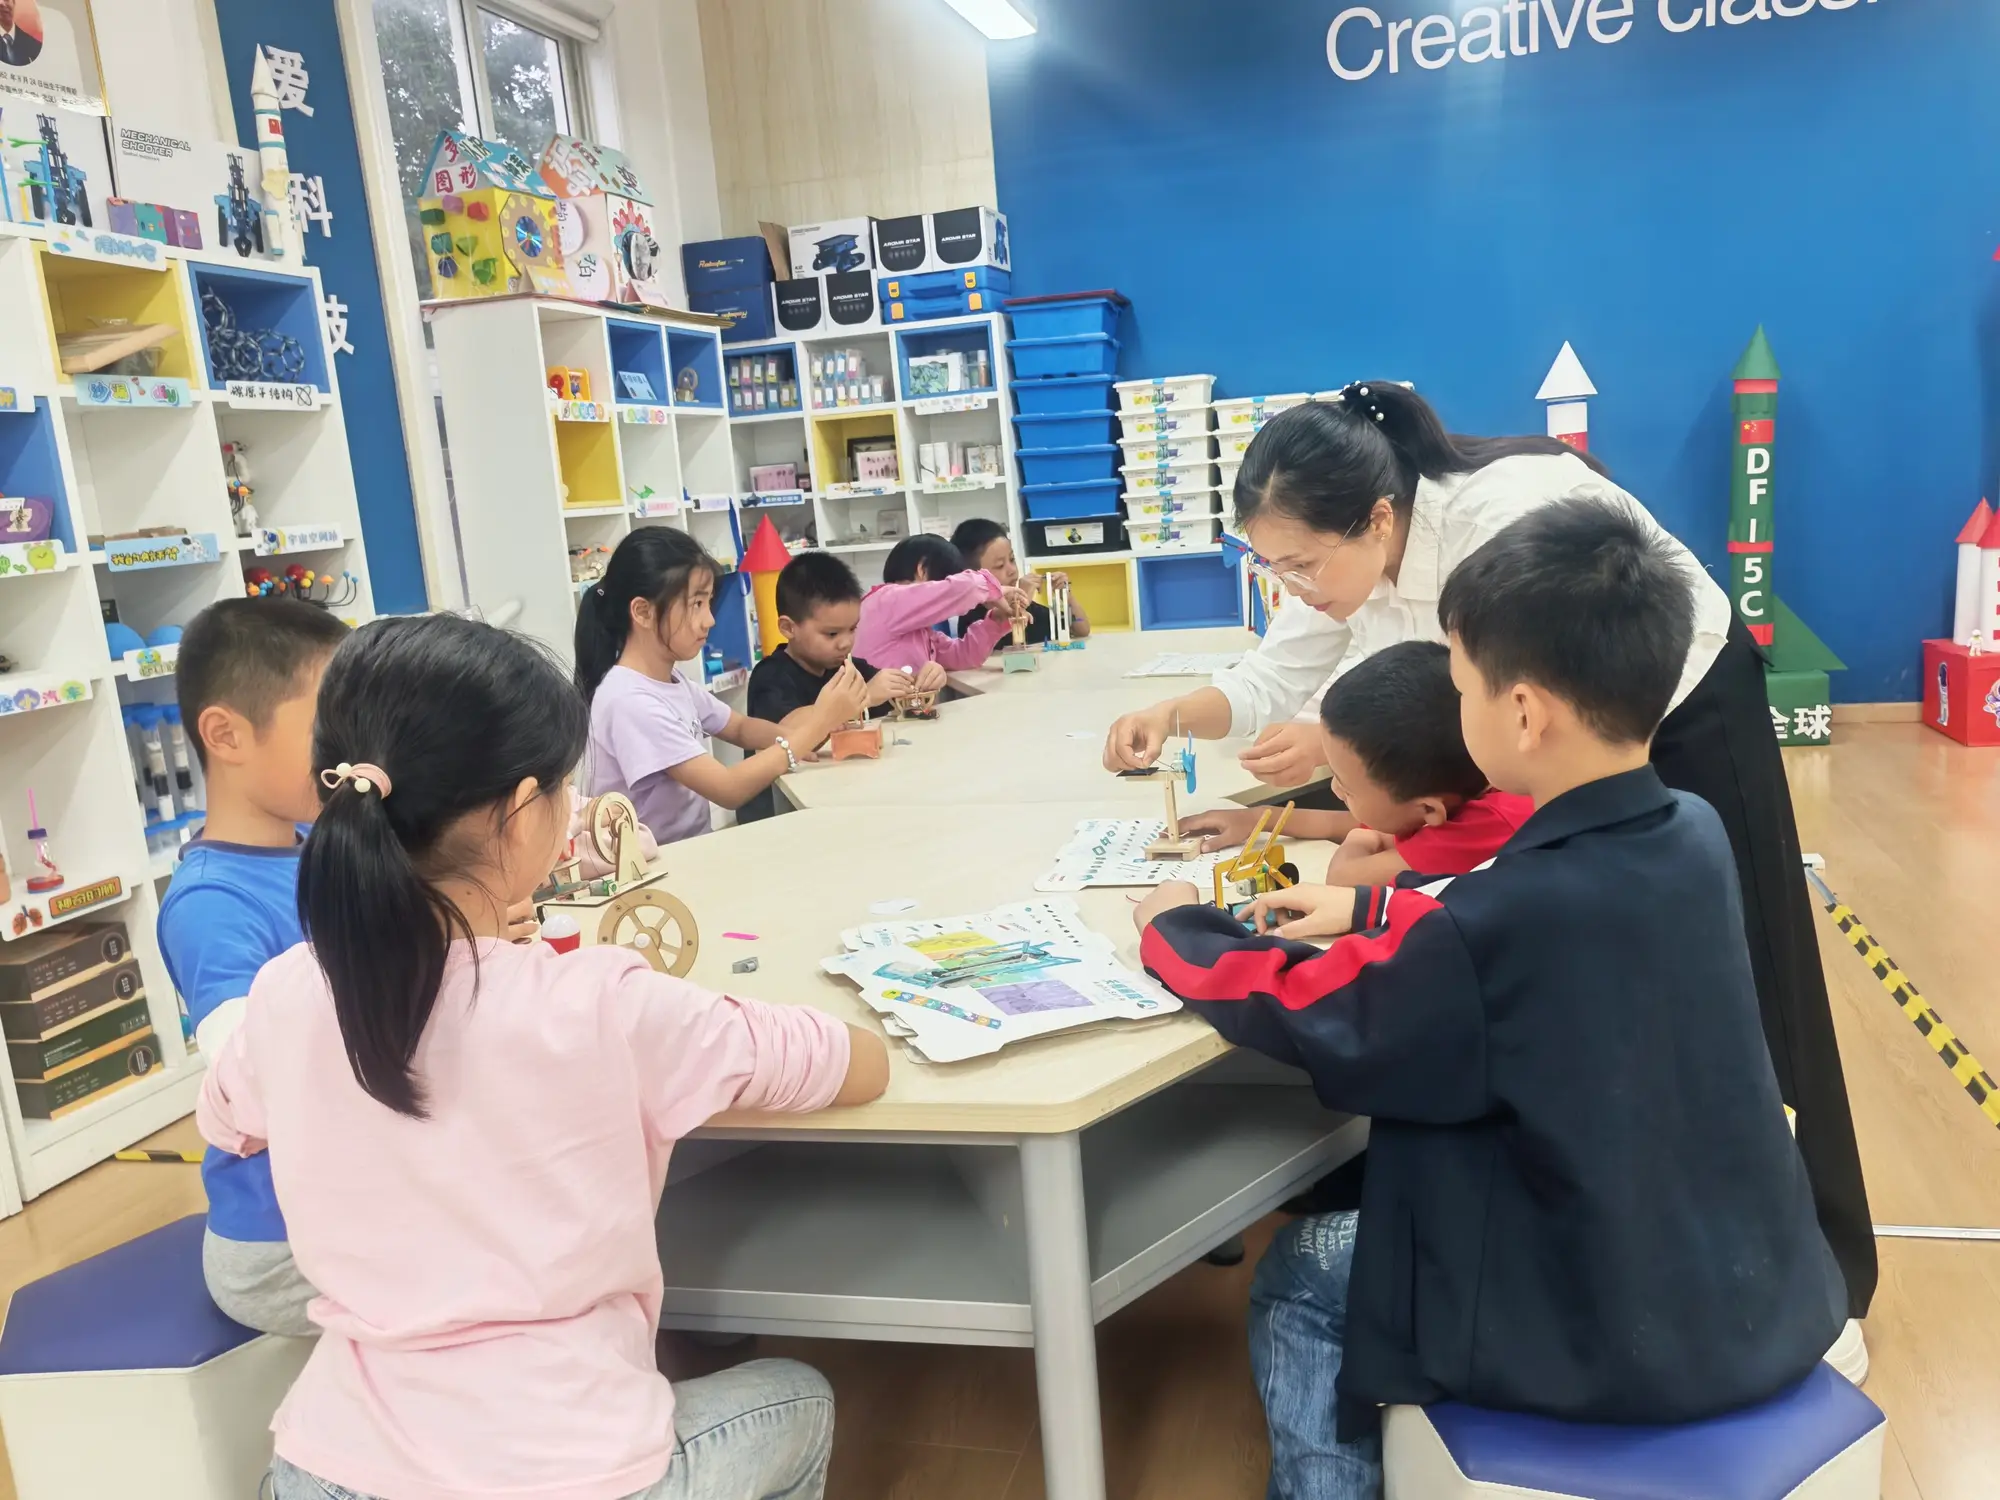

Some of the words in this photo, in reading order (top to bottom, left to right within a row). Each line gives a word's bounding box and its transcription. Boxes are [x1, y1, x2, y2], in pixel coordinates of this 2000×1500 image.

[1326, 0, 1634, 80] Creative
[120, 128, 191, 152] MECHANICAL
[122, 139, 174, 158] SHOOTER
[1769, 704, 1832, 740] 全球
